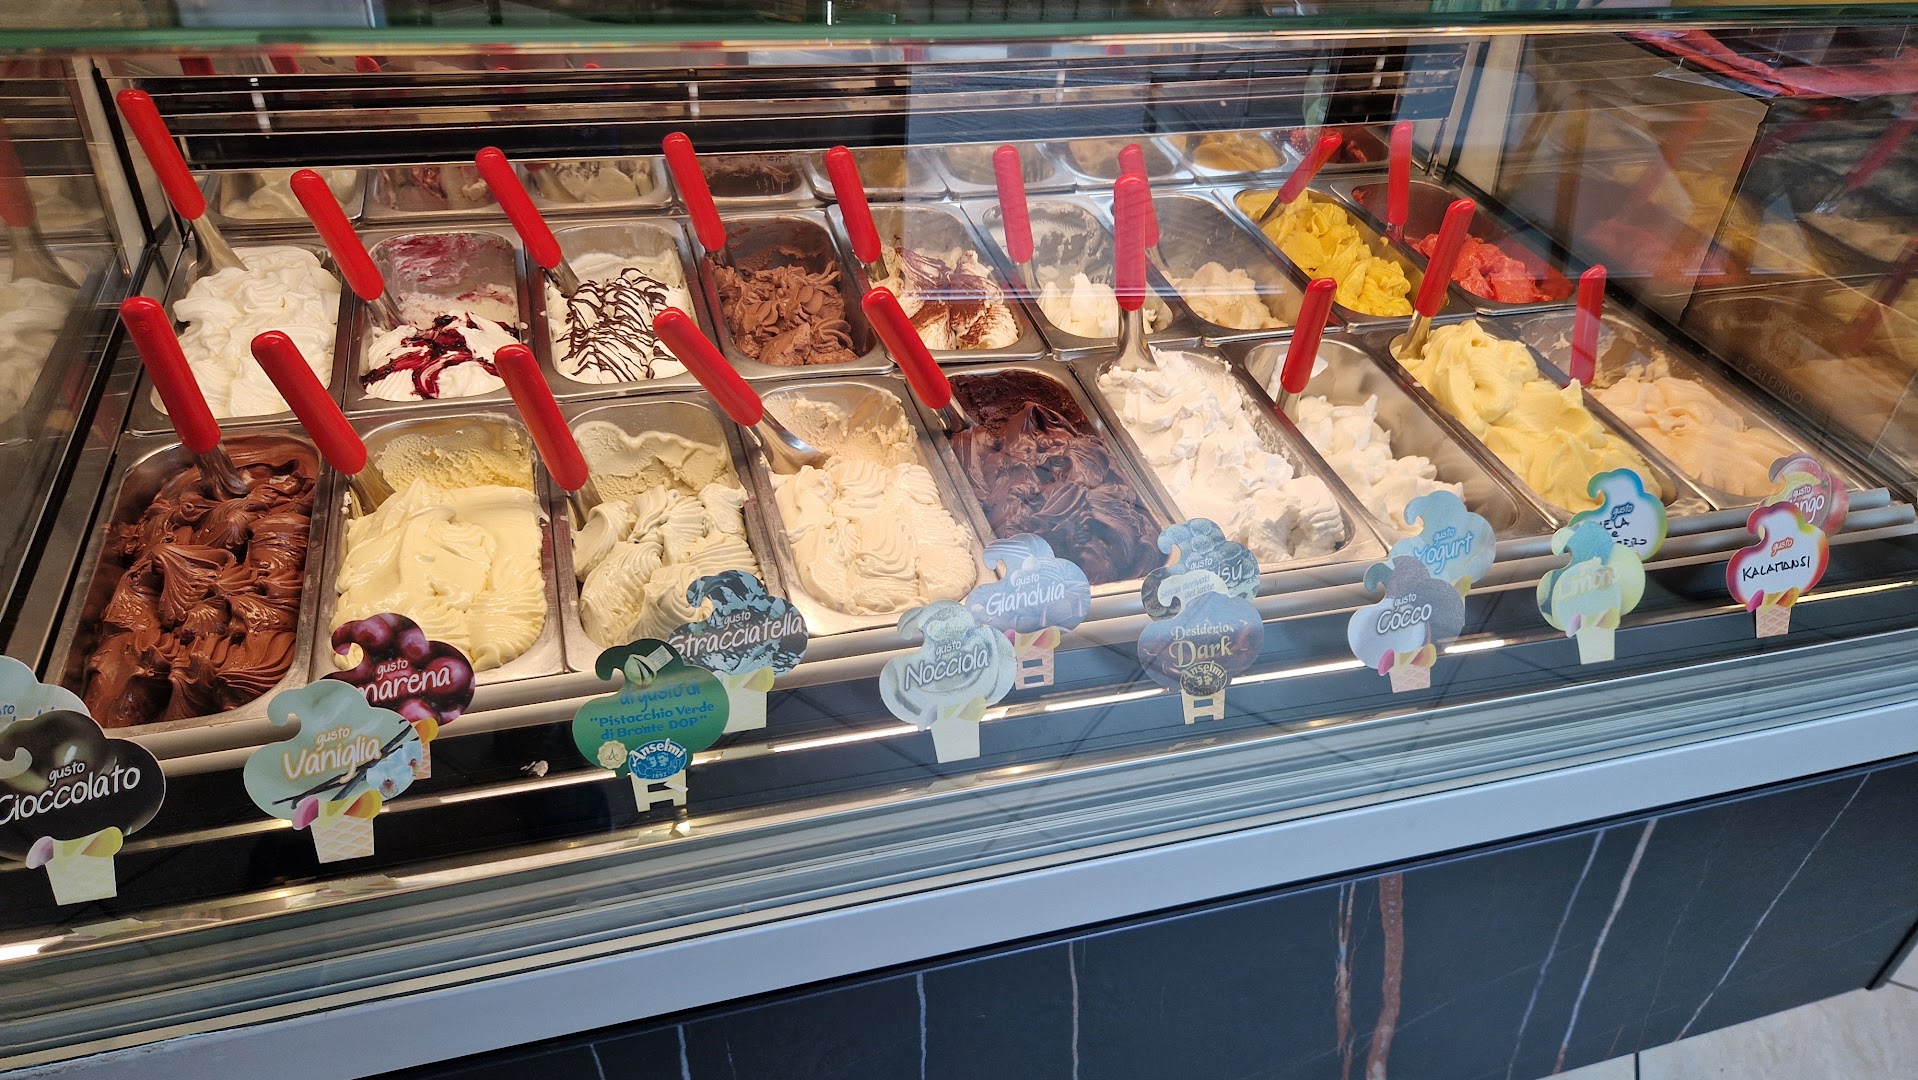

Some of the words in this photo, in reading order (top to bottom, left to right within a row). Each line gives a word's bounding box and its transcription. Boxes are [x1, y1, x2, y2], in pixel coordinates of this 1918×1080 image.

[1793, 485, 1811, 502] gusto
[1612, 502, 1634, 520] gusto
[1789, 495, 1825, 523] ngo
[1600, 517, 1630, 530] ELA
[1434, 528, 1455, 545] gusto
[1772, 538, 1793, 556] gusto
[1191, 556, 1213, 570] gusto
[1415, 531, 1473, 574] Yogurt
[1016, 573, 1040, 591] gusto
[1217, 560, 1242, 583] isú
[985, 582, 1065, 617] Gianduia
[1394, 593, 1417, 611] gusto
[724, 610, 751, 630] gusto
[1377, 604, 1432, 634] Cocco
[668, 612, 803, 658] Stracciatella
[1171, 623, 1229, 641] Desiderio
[935, 640, 962, 661] gusto
[1168, 636, 1233, 668] Dark
[377, 659, 409, 681] gusto
[905, 644, 989, 691] Nocciola
[1181, 660, 1227, 684] Anselmi
[357, 667, 451, 702] marena
[675, 702, 715, 716] Verde
[317, 727, 351, 749] gusto
[601, 729, 614, 740] di
[617, 723, 664, 738] Bronte
[284, 736, 382, 784] Vaniglia
[629, 738, 687, 767] Anselmi
[49, 761, 86, 788] gusto
[0, 764, 141, 826] Cioccolato
